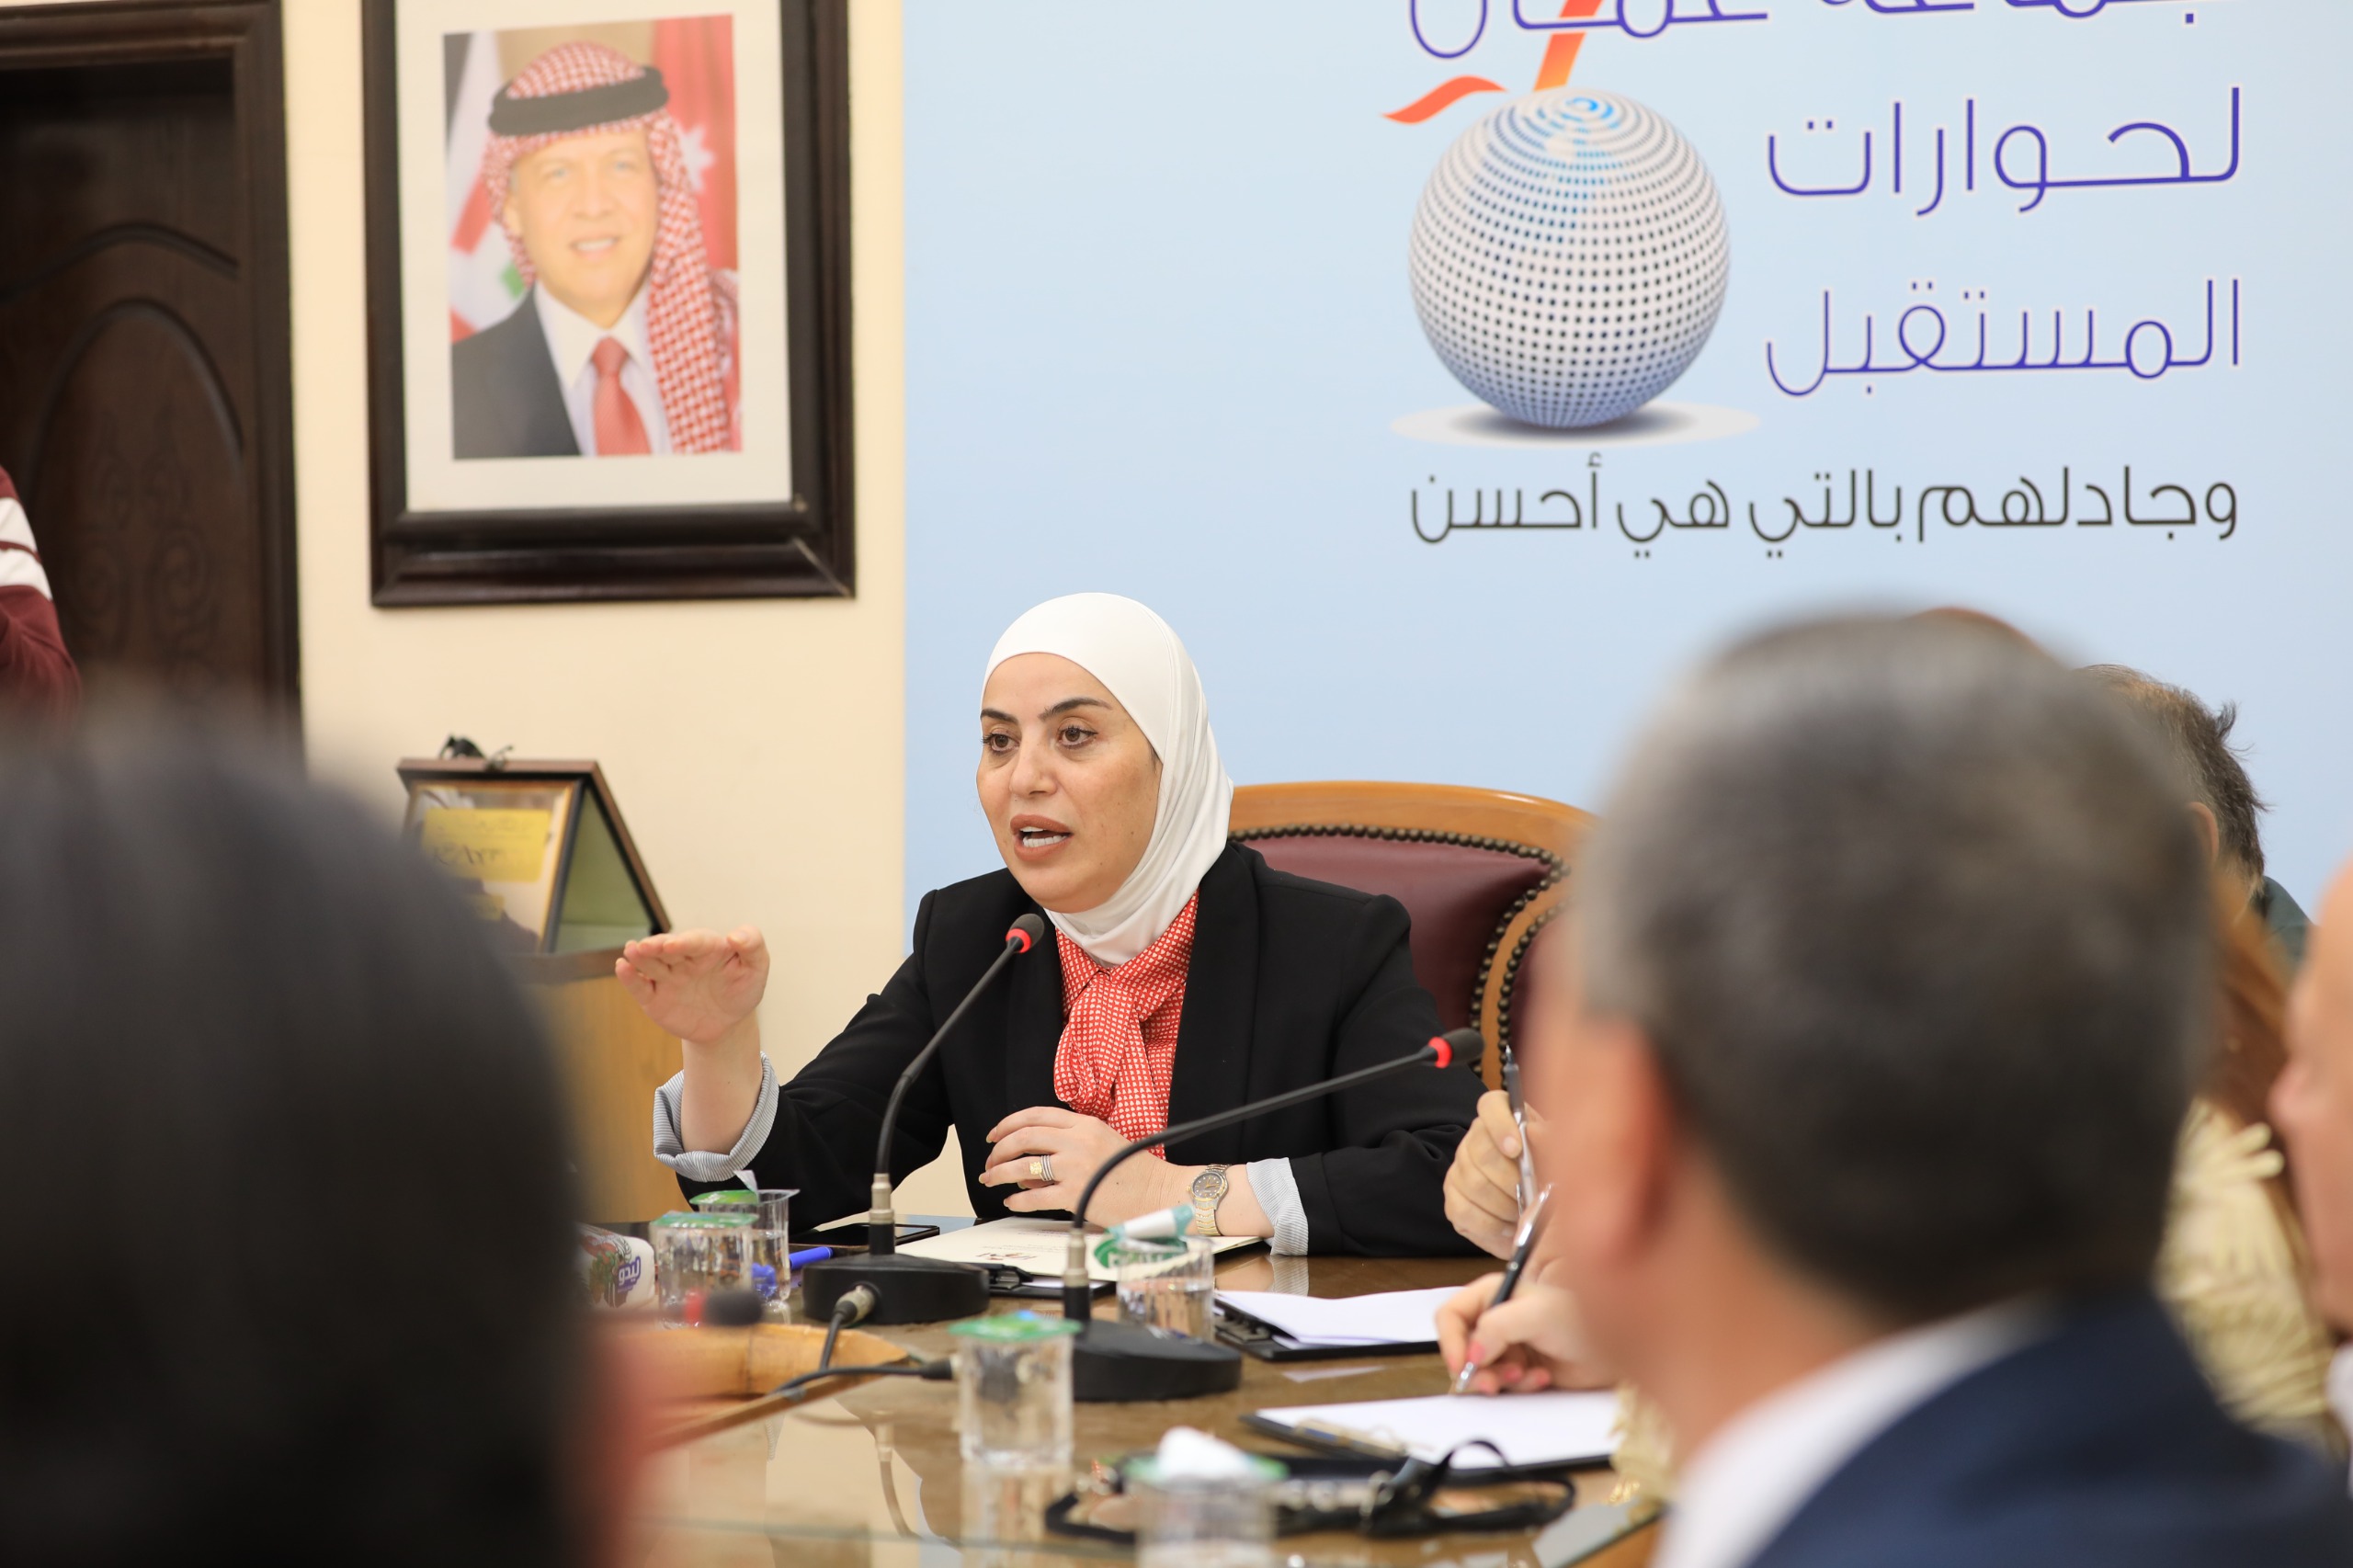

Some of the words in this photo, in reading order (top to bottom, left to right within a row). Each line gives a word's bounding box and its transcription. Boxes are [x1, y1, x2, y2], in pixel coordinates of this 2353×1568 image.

[1768, 85, 2241, 217] لحوارات
[1767, 278, 2239, 397] المستقبل
[1412, 452, 1602, 544] أحسن
[1617, 480, 1731, 559] هي
[1748, 468, 1903, 559] بالتي
[1918, 465, 2238, 542] وجادلهم
